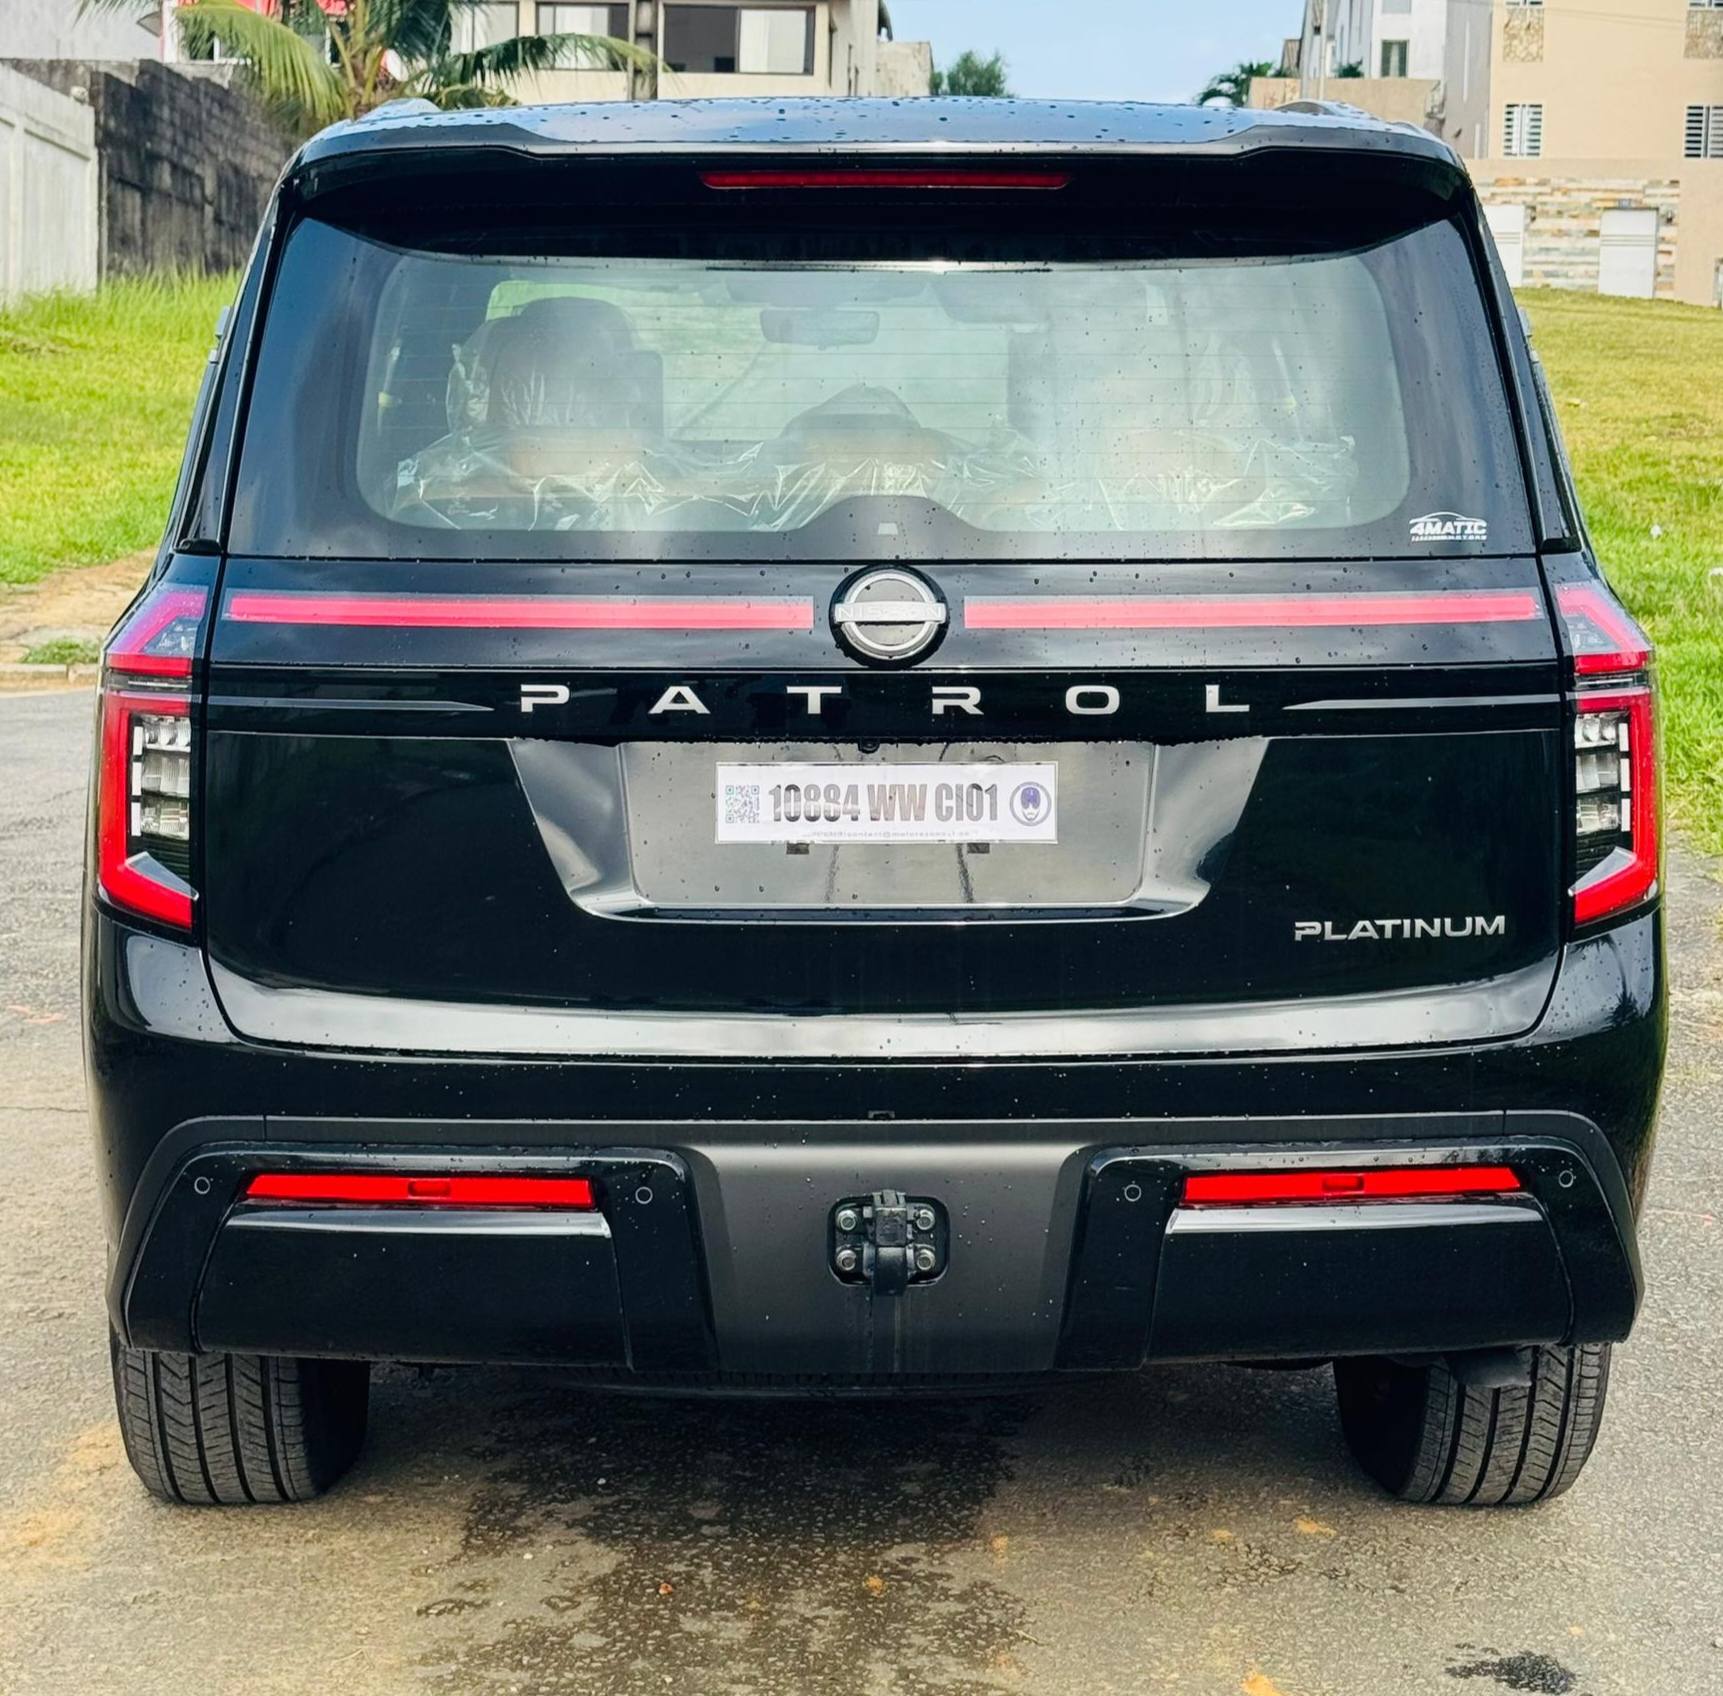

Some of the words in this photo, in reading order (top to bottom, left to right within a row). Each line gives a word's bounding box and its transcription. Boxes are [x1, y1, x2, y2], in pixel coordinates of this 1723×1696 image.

[1409, 521, 1488, 535] 4MATIC
[520, 684, 1250, 715] PATROL
[768, 783, 861, 822] 10884
[867, 783, 928, 822] WW
[1294, 915, 1506, 942] PLATINUM
